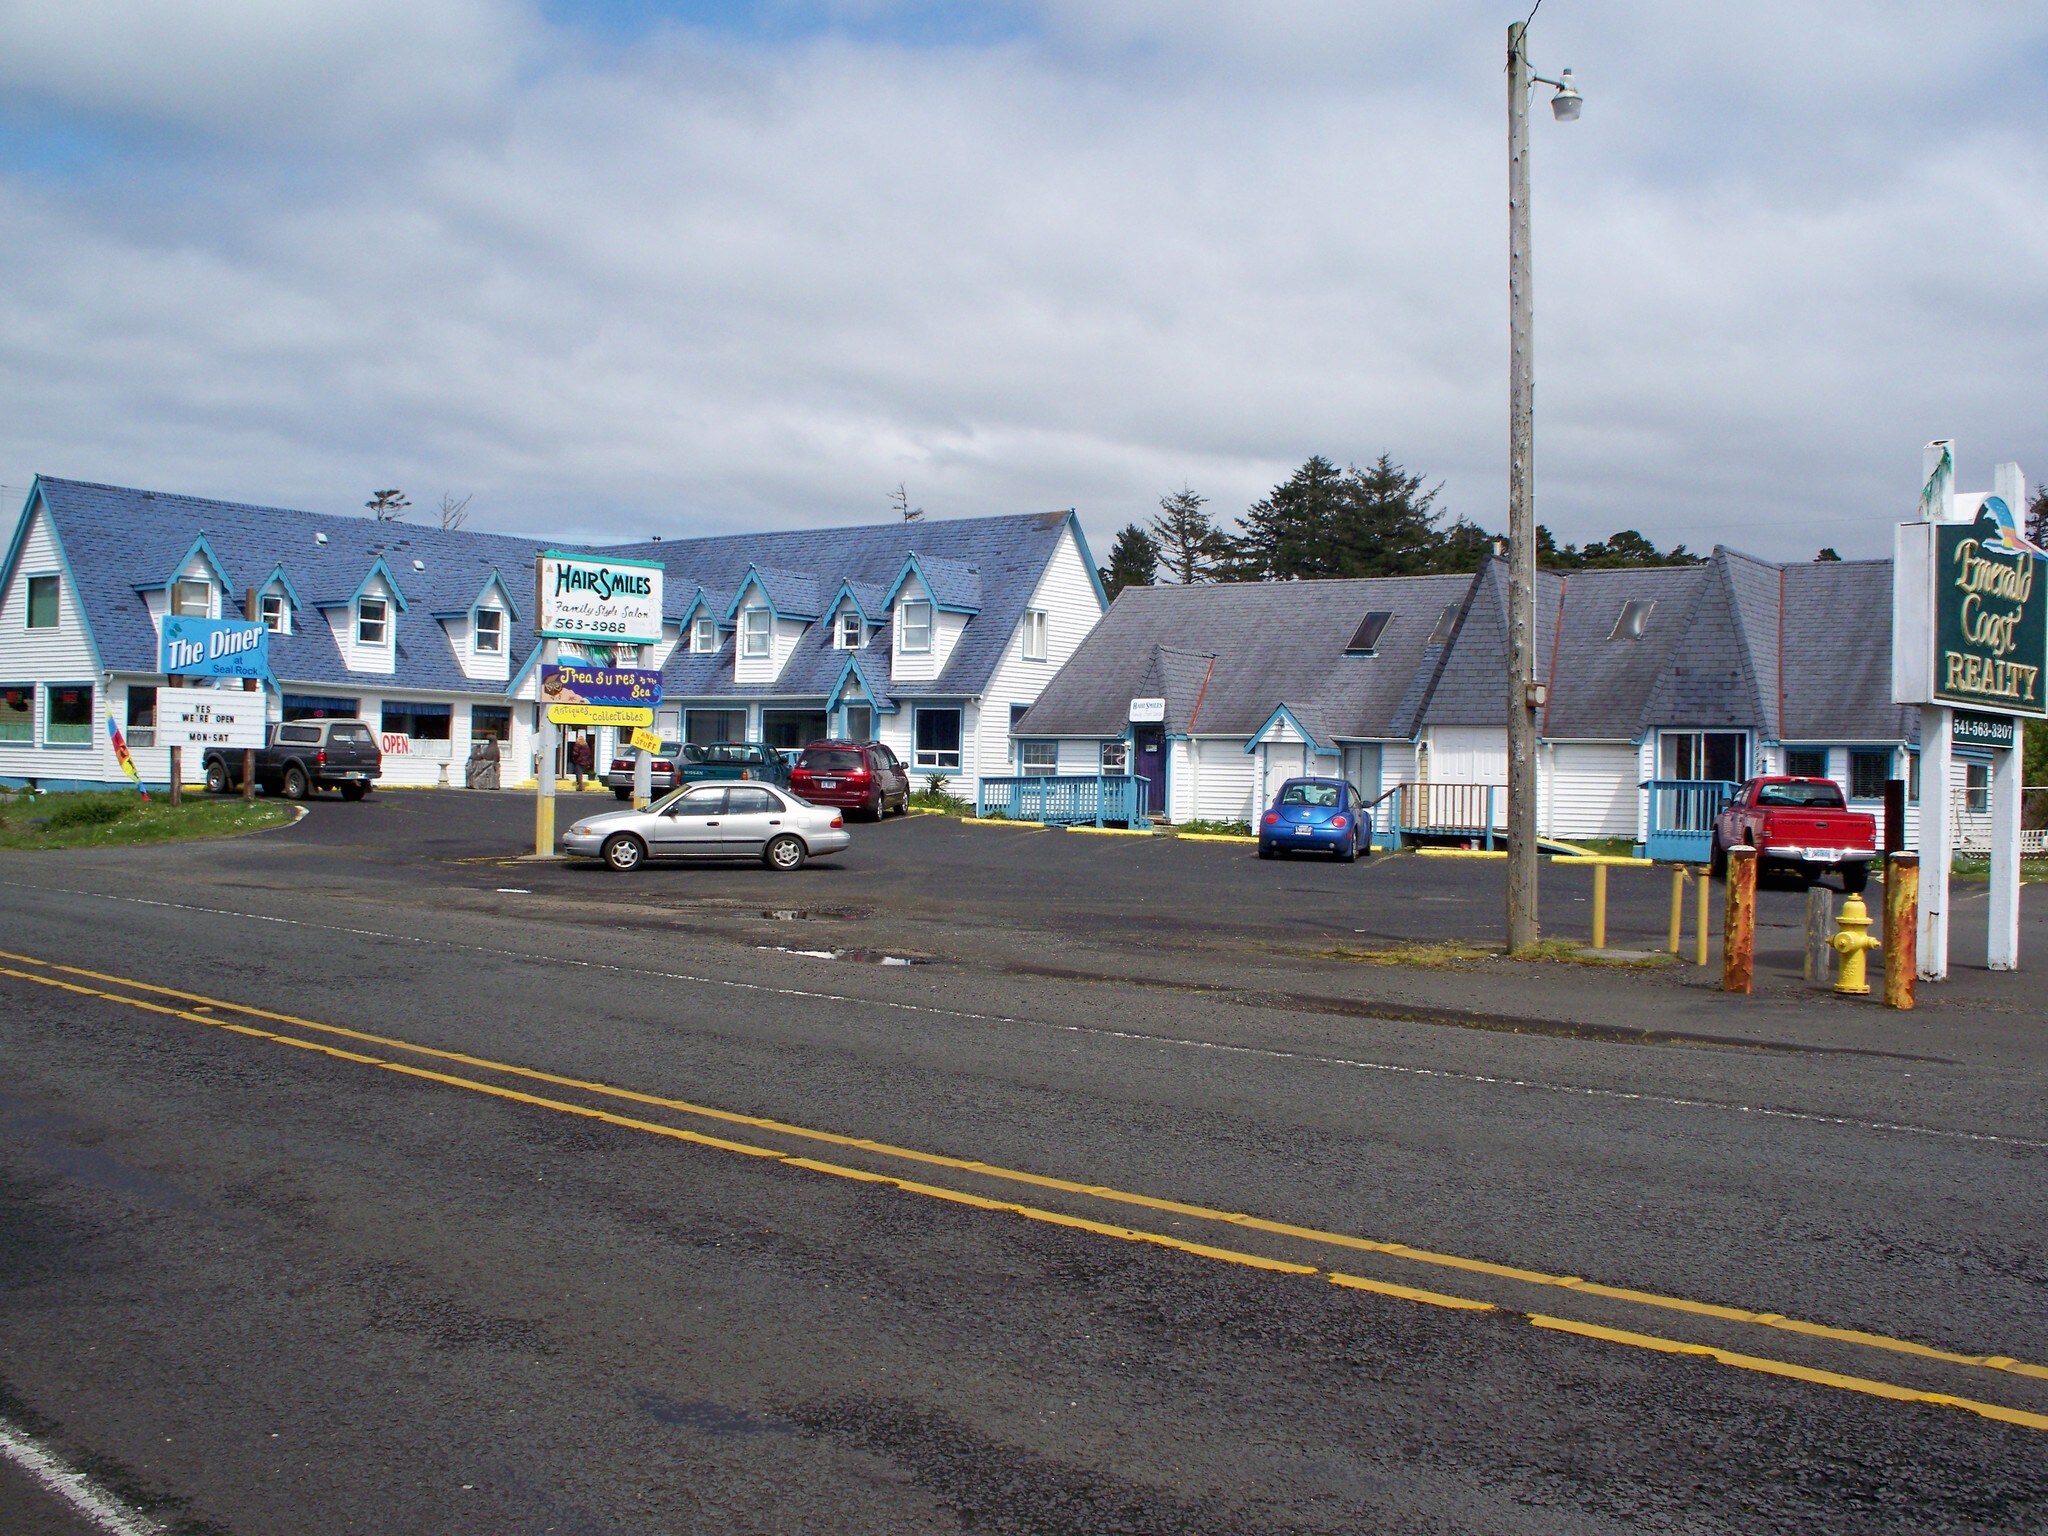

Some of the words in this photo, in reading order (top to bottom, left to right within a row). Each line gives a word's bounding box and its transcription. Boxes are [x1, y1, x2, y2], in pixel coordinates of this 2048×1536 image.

[1954, 538, 2034, 603] Emerald
[555, 618, 626, 633] 563-3988
[1961, 593, 2022, 657] Coast
[168, 638, 205, 671] The
[210, 626, 264, 660] Diner
[234, 656, 243, 665] at
[212, 665, 233, 674] Seal
[235, 666, 258, 676] Rock
[1944, 650, 2039, 701] REALTY
[631, 684, 651, 698] Sea
[195, 704, 211, 714] YES
[182, 713, 209, 723] WE'RE
[216, 714, 235, 723] OPEN
[1953, 718, 2013, 740] 541-563-3207
[189, 732, 230, 742] MON-SAT
[382, 734, 409, 754] OPEN
